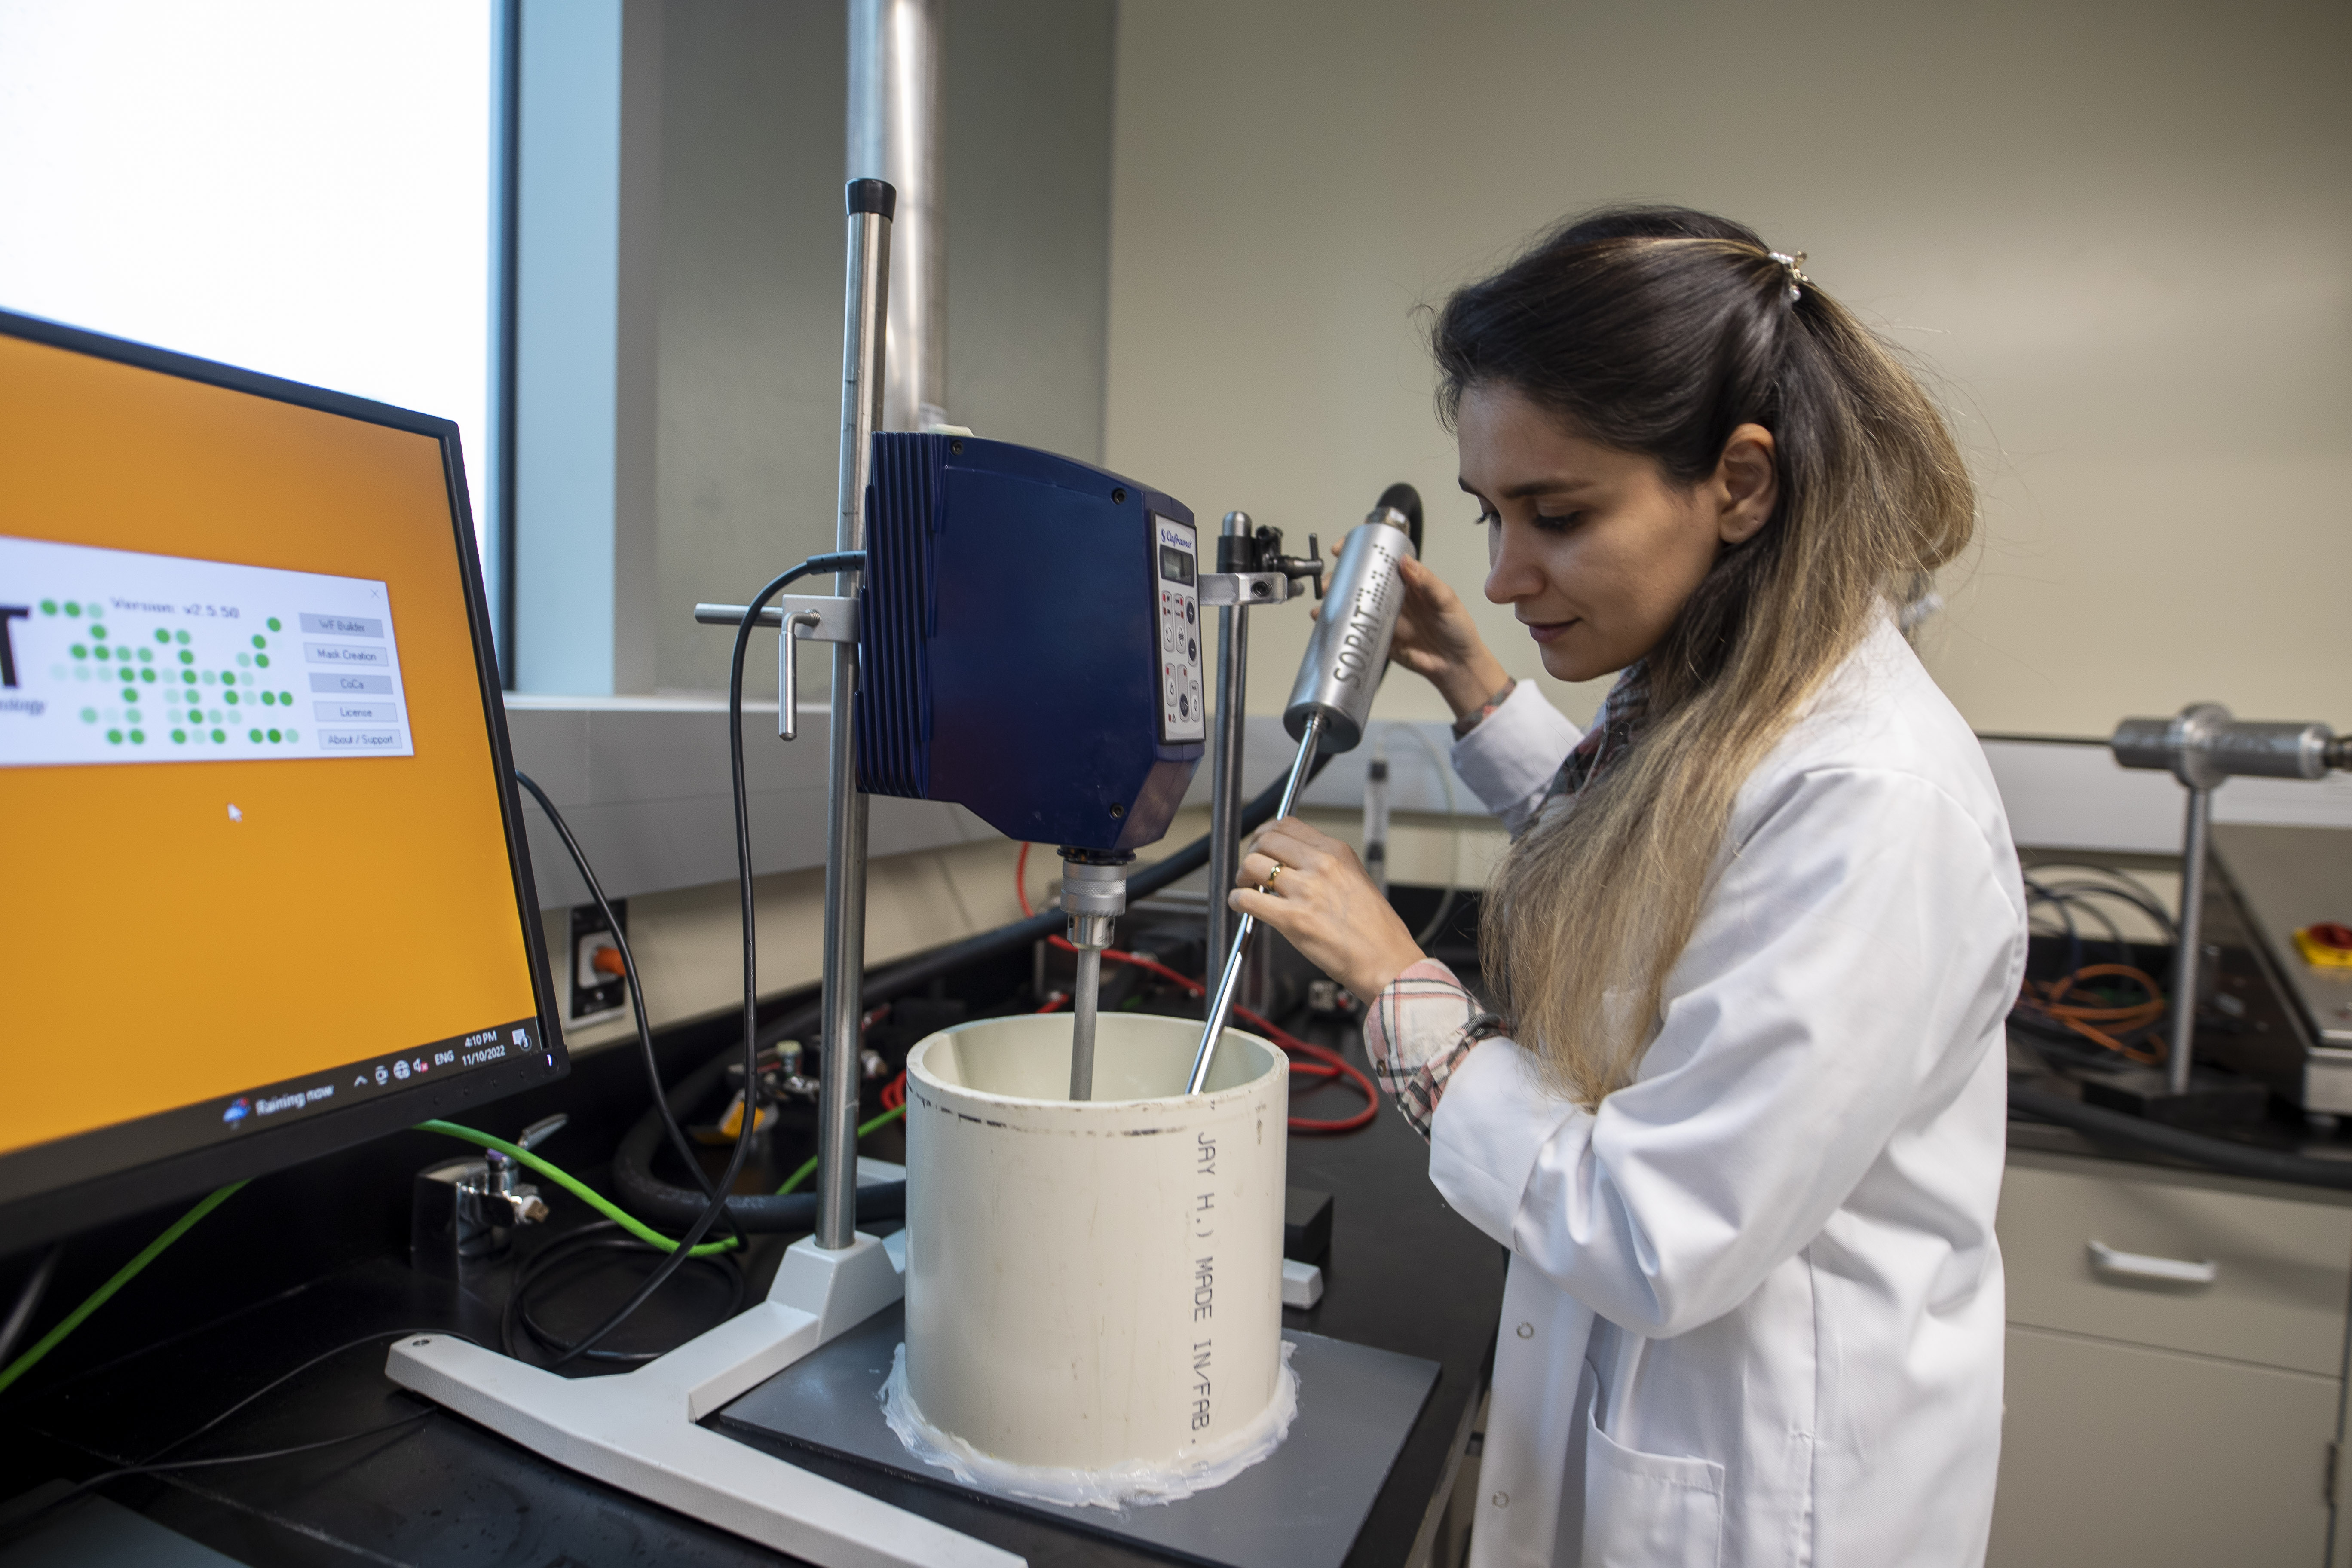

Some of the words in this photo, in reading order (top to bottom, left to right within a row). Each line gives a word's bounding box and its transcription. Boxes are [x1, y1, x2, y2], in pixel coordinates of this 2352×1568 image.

[337, 620, 365, 632] Builder
[317, 648, 341, 659] Mask
[343, 649, 377, 661] Creation
[1333, 605, 1381, 690] SOPAT
[340, 706, 373, 718] License
[328, 735, 353, 745] About
[361, 734, 393, 745] Support
[465, 1034, 482, 1048] 4:10
[482, 1030, 497, 1044] PM
[434, 1050, 455, 1066] ENG
[462, 1044, 506, 1066] 11/10/2022
[255, 1092, 306, 1116] Raining
[306, 1084, 334, 1102] now
[1197, 1131, 1216, 1175] JAY
[1196, 1192, 1214, 1238] H.)
[1194, 1256, 1213, 1323] MADE
